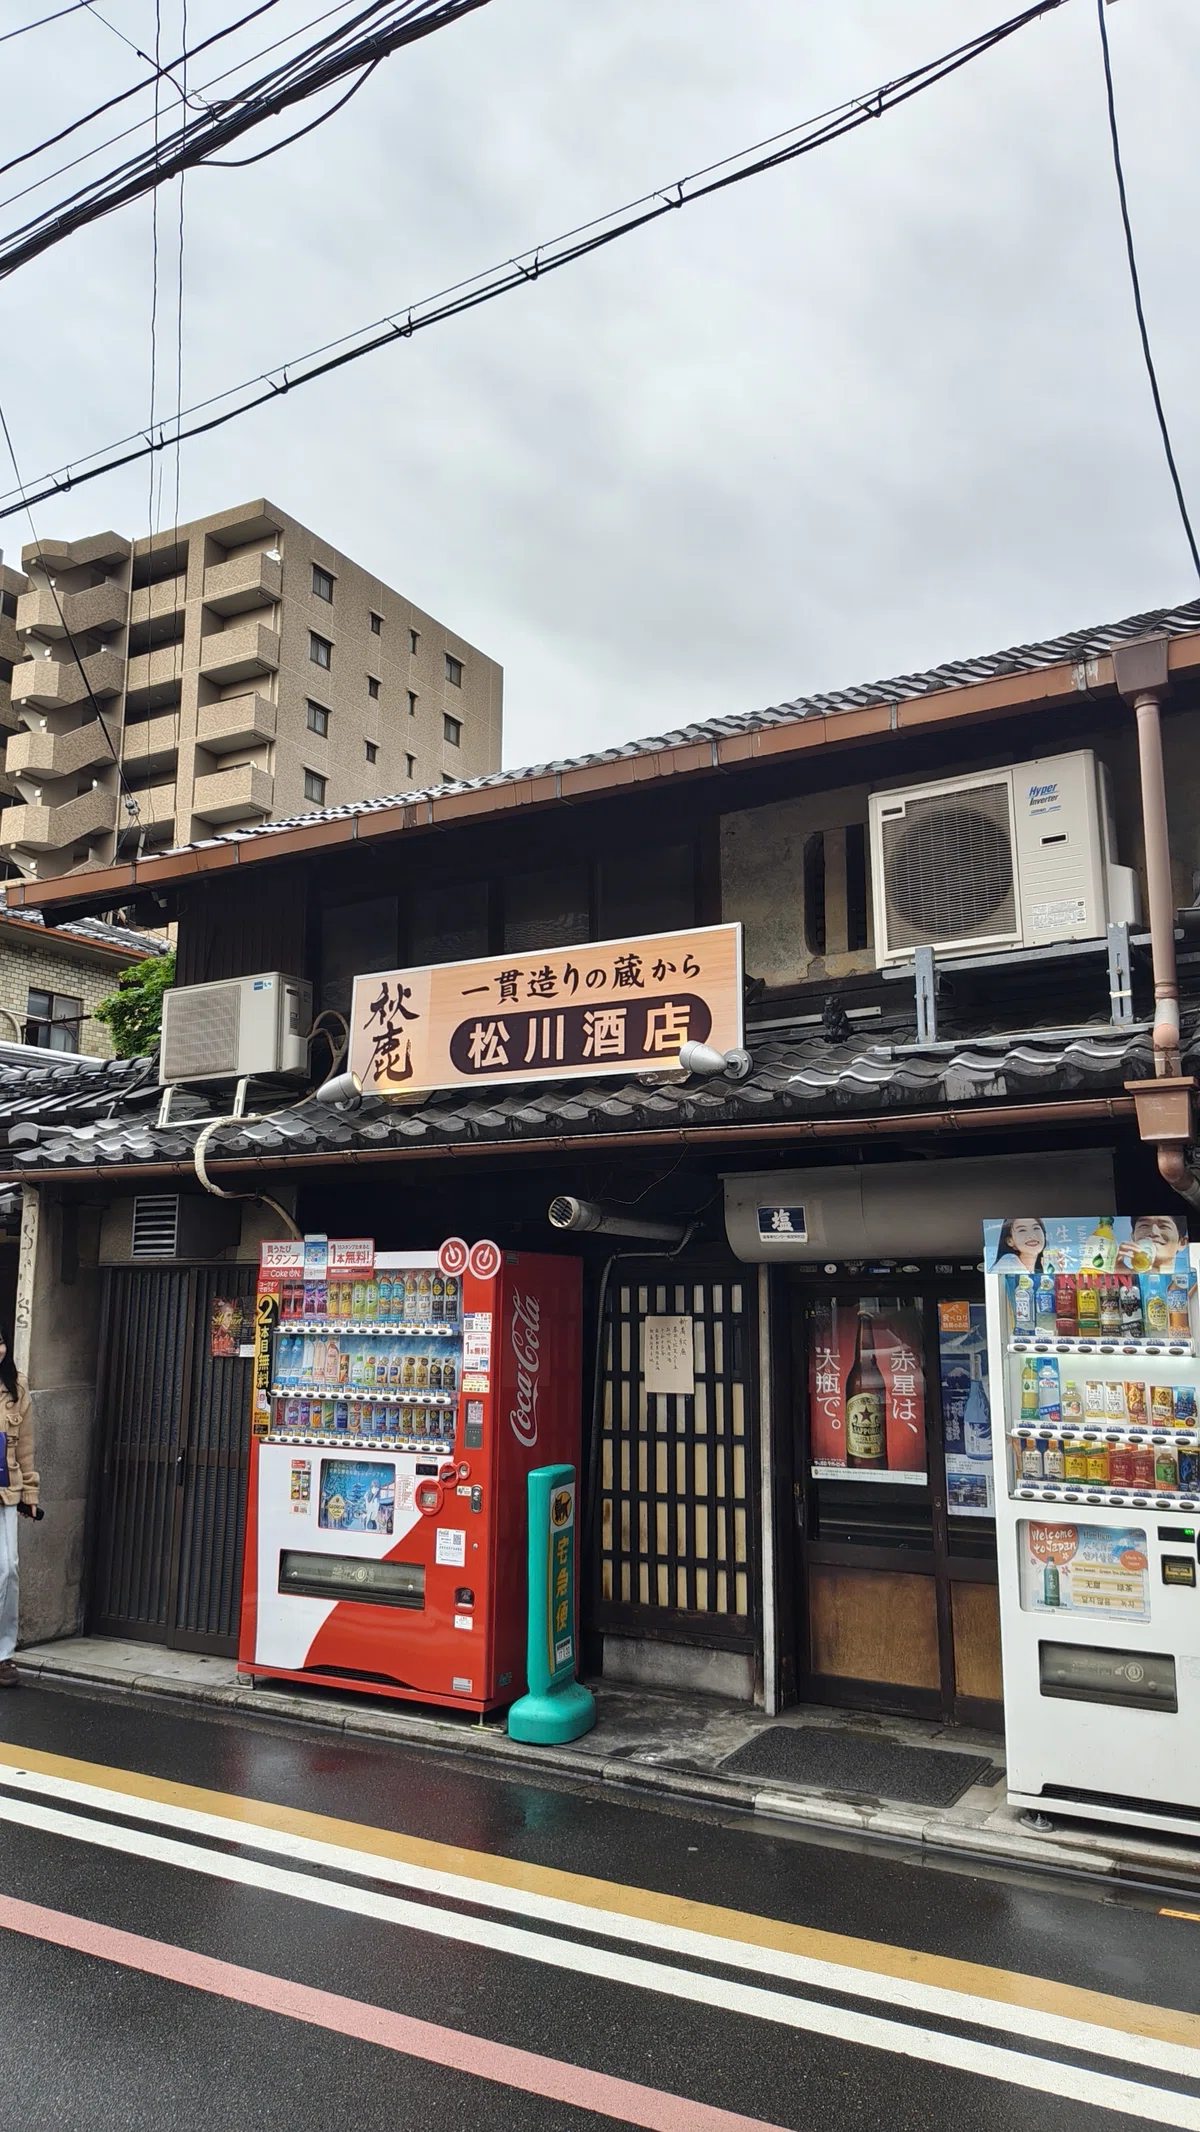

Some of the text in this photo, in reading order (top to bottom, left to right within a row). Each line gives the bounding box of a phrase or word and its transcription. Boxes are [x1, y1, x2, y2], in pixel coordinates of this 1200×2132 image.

[1029, 783, 1058, 797] Hyper
[1029, 795, 1059, 806] Inverter
[461, 953, 701, 1005] 一貫造りの蔵から
[363, 981, 420, 1082] 秋鹿
[468, 1002, 690, 1069] 松川酒店
[771, 1208, 794, 1232] 塩
[267, 1244, 292, 1253] 買うたび
[1056, 1224, 1078, 1269] 生茶
[266, 1253, 300, 1265] スタンプ
[270, 1269, 288, 1278] Coke
[1059, 1274, 1132, 1289] KIRIN
[943, 1314, 968, 1322] 食べログ
[256, 1294, 273, 1389] 2本目無料
[510, 1284, 540, 1447] Coca-Cola
[815, 1349, 842, 1430] 大瓶で。
[890, 1351, 918, 1434] 赤星は、
[1031, 1528, 1073, 1541] Welcome
[1034, 1541, 1077, 1553] to Japan
[555, 1535, 570, 1633] 宅急便
